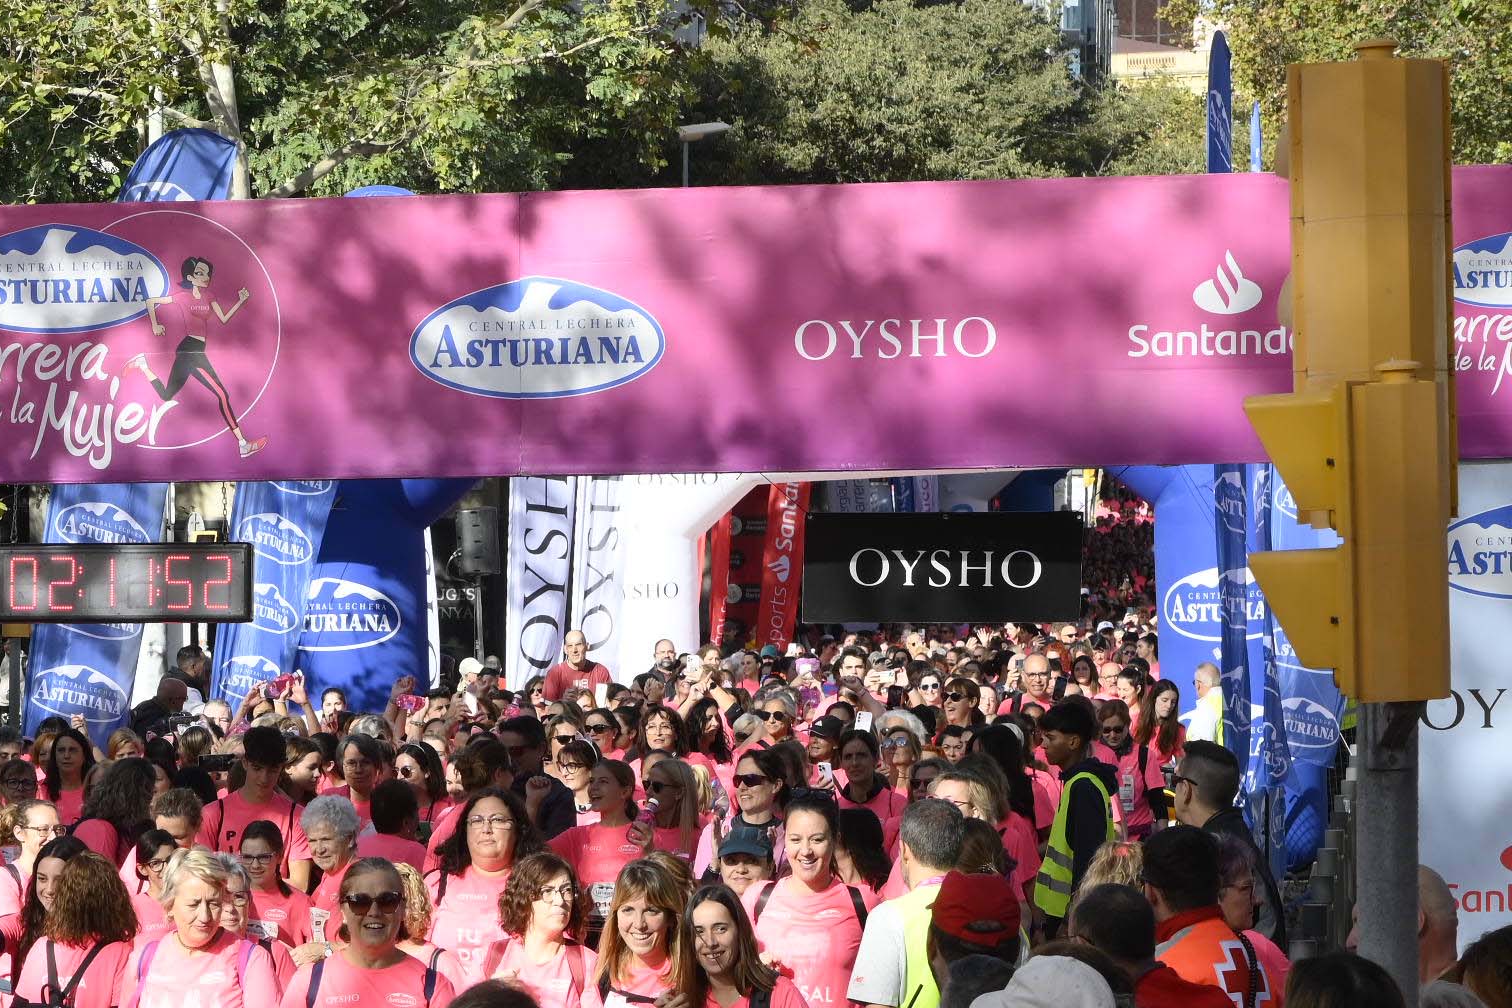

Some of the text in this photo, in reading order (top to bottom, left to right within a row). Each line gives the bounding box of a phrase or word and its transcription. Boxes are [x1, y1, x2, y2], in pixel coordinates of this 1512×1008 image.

[72, 261, 144, 271] LECHERA
[1468, 258, 1512, 267] CENTRA
[468, 317, 637, 332] CENTRAL LECHERA
[794, 316, 997, 361] OYSHO
[1128, 323, 1294, 357] Santand
[1454, 313, 1512, 343] arre
[430, 325, 644, 369] ASTURIANA
[1477, 343, 1497, 371] la
[11, 384, 35, 424] la
[29, 377, 180, 470] Mujer
[9, 555, 232, 611] 02:11:52
[519, 477, 570, 669] OYSH
[849, 548, 1043, 589] OYSHO
[302, 613, 392, 632] TURIANA
[338, 602, 387, 611] LECHERA
[34, 678, 121, 716] ASTURIANA
